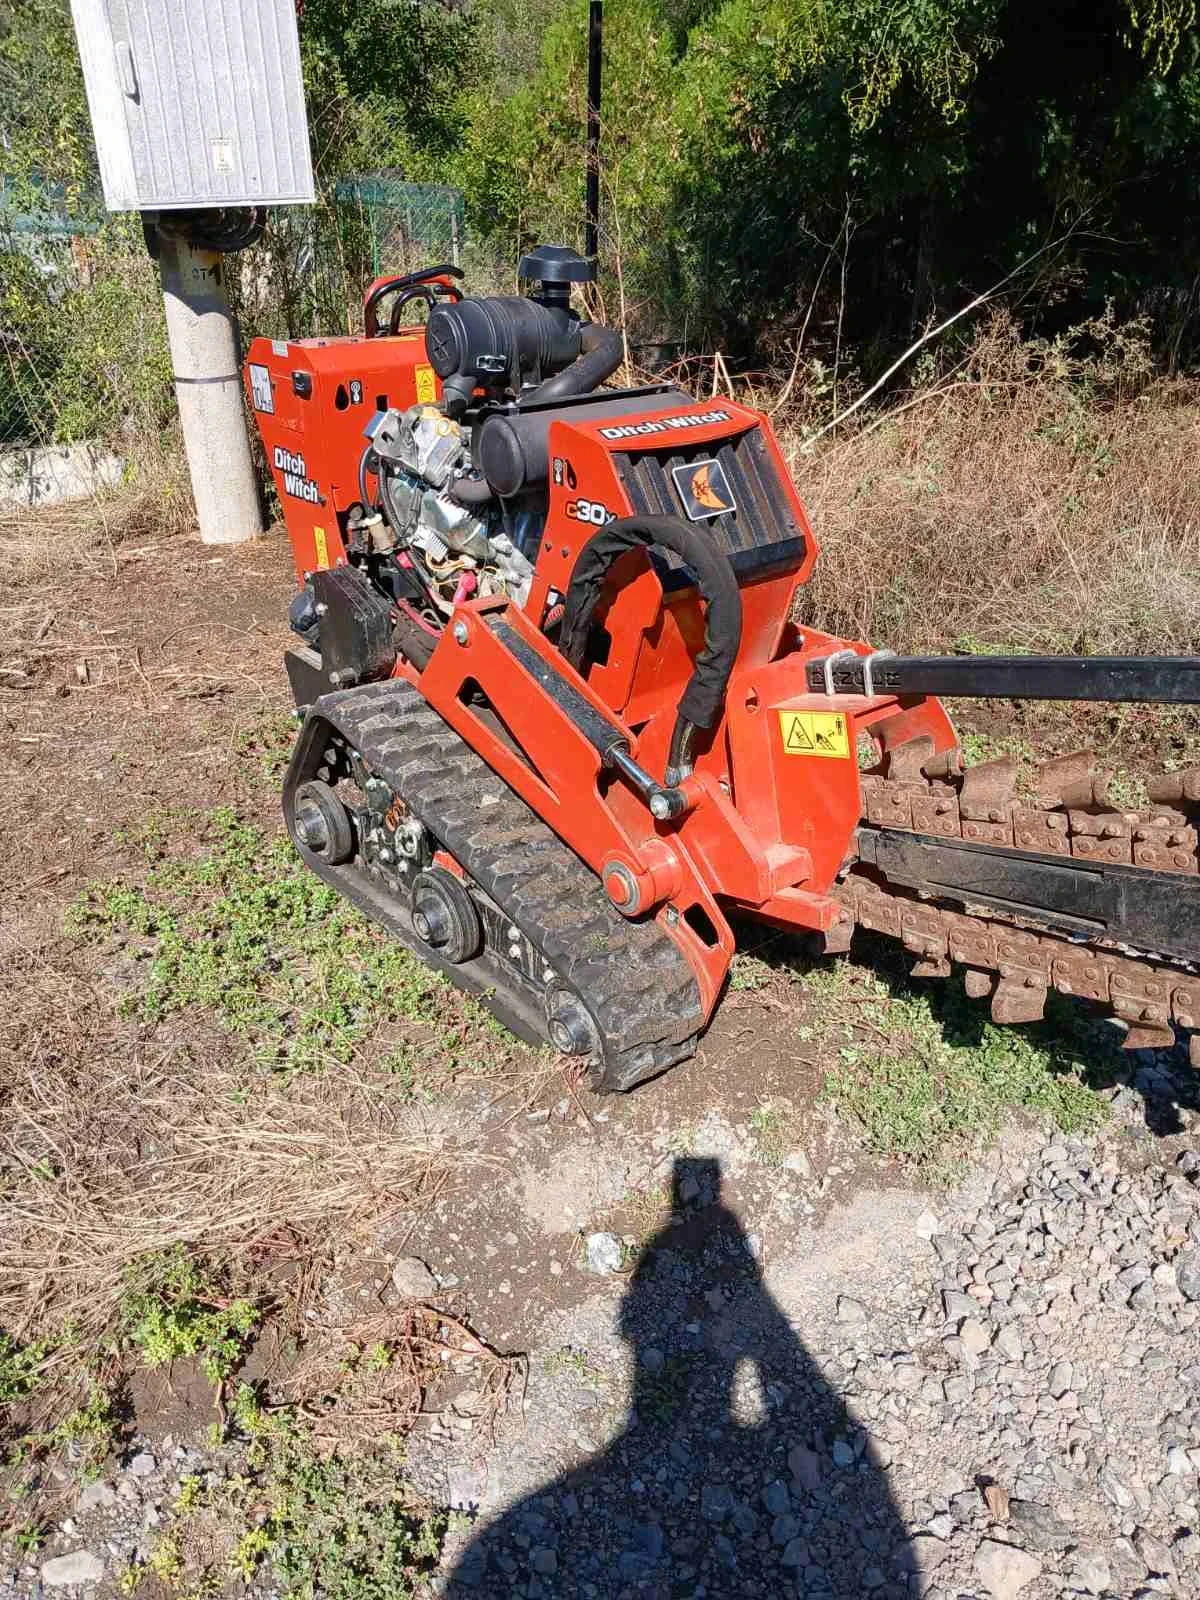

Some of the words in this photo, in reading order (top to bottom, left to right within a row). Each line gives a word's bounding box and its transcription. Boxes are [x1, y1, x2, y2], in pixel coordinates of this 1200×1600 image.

[600, 421, 666, 440] Ditch
[663, 411, 730, 428] Witch
[274, 447, 306, 477] Ditch
[284, 472, 318, 503] Witch
